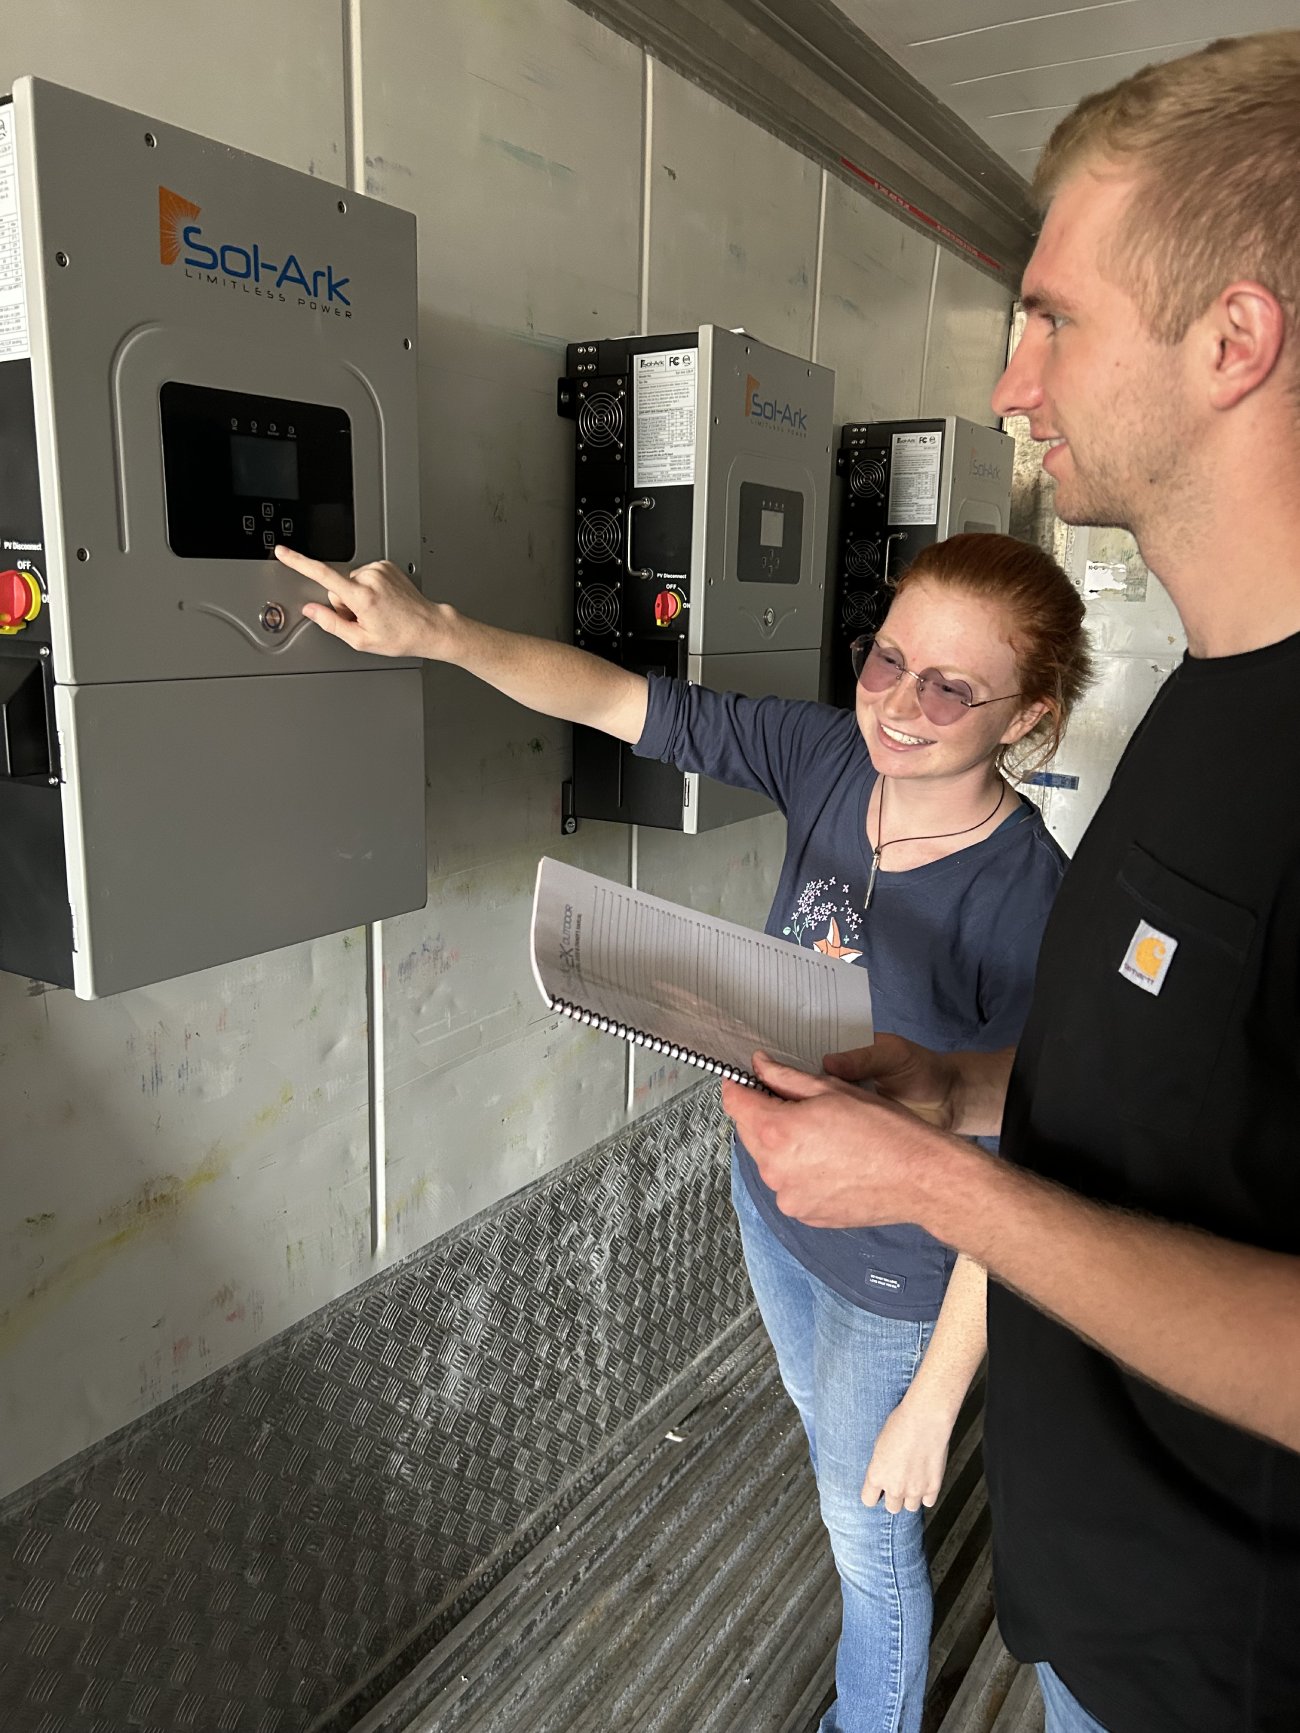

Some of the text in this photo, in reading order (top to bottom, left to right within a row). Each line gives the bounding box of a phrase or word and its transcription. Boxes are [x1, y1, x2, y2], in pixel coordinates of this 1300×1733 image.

[183, 226, 351, 306] Sol-Ark
[185, 269, 352, 319] LIMITLESS POWER
[751, 393, 808, 431] Sol-Ark
[17, 560, 31, 570] OFF
